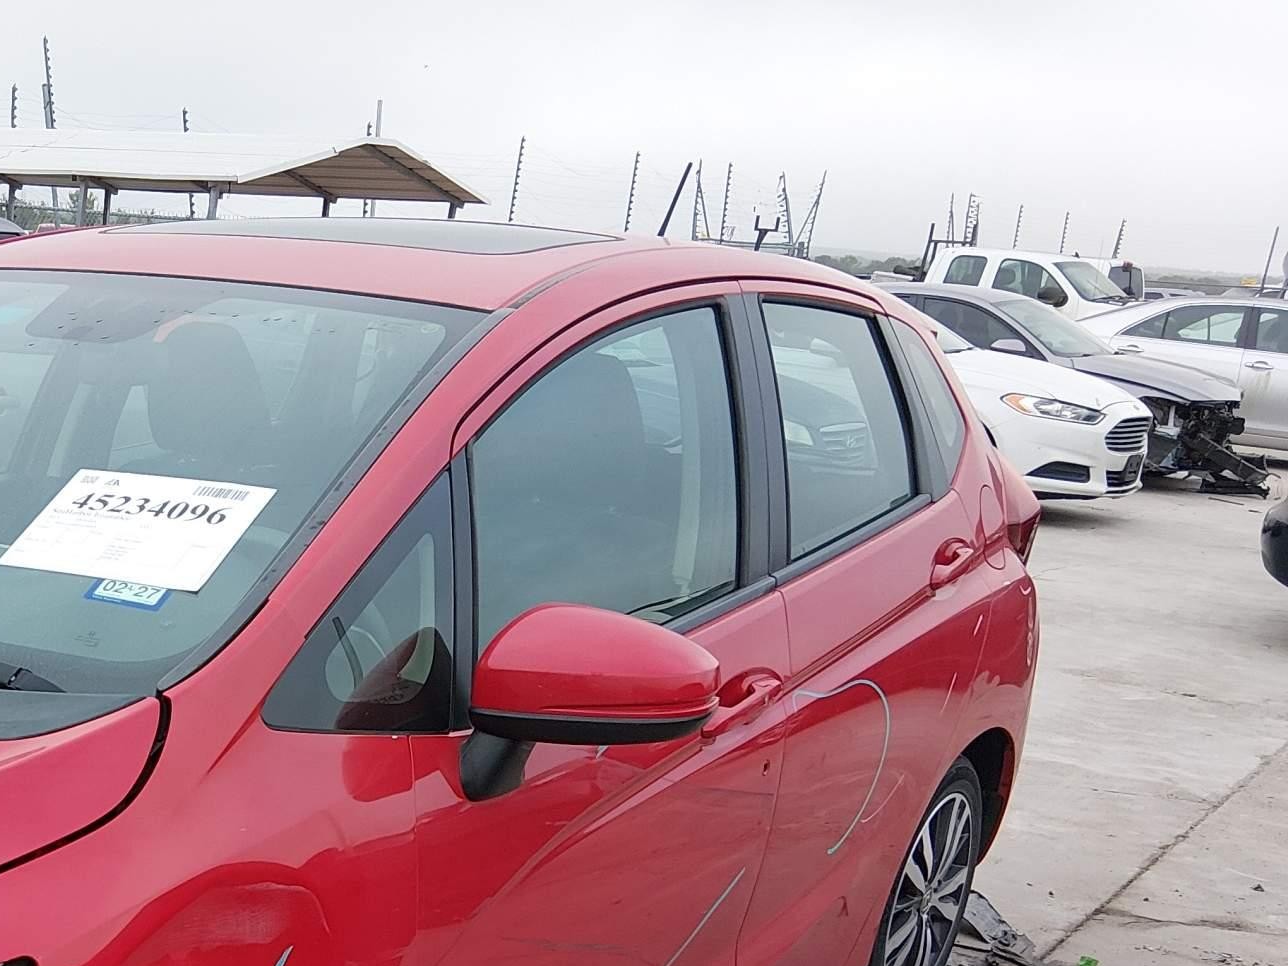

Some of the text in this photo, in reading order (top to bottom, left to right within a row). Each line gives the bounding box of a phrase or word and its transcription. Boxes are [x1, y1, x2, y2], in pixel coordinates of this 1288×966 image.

[72, 492, 233, 525] 45234096
[103, 579, 129, 594] 02
[133, 585, 162, 600] 27
